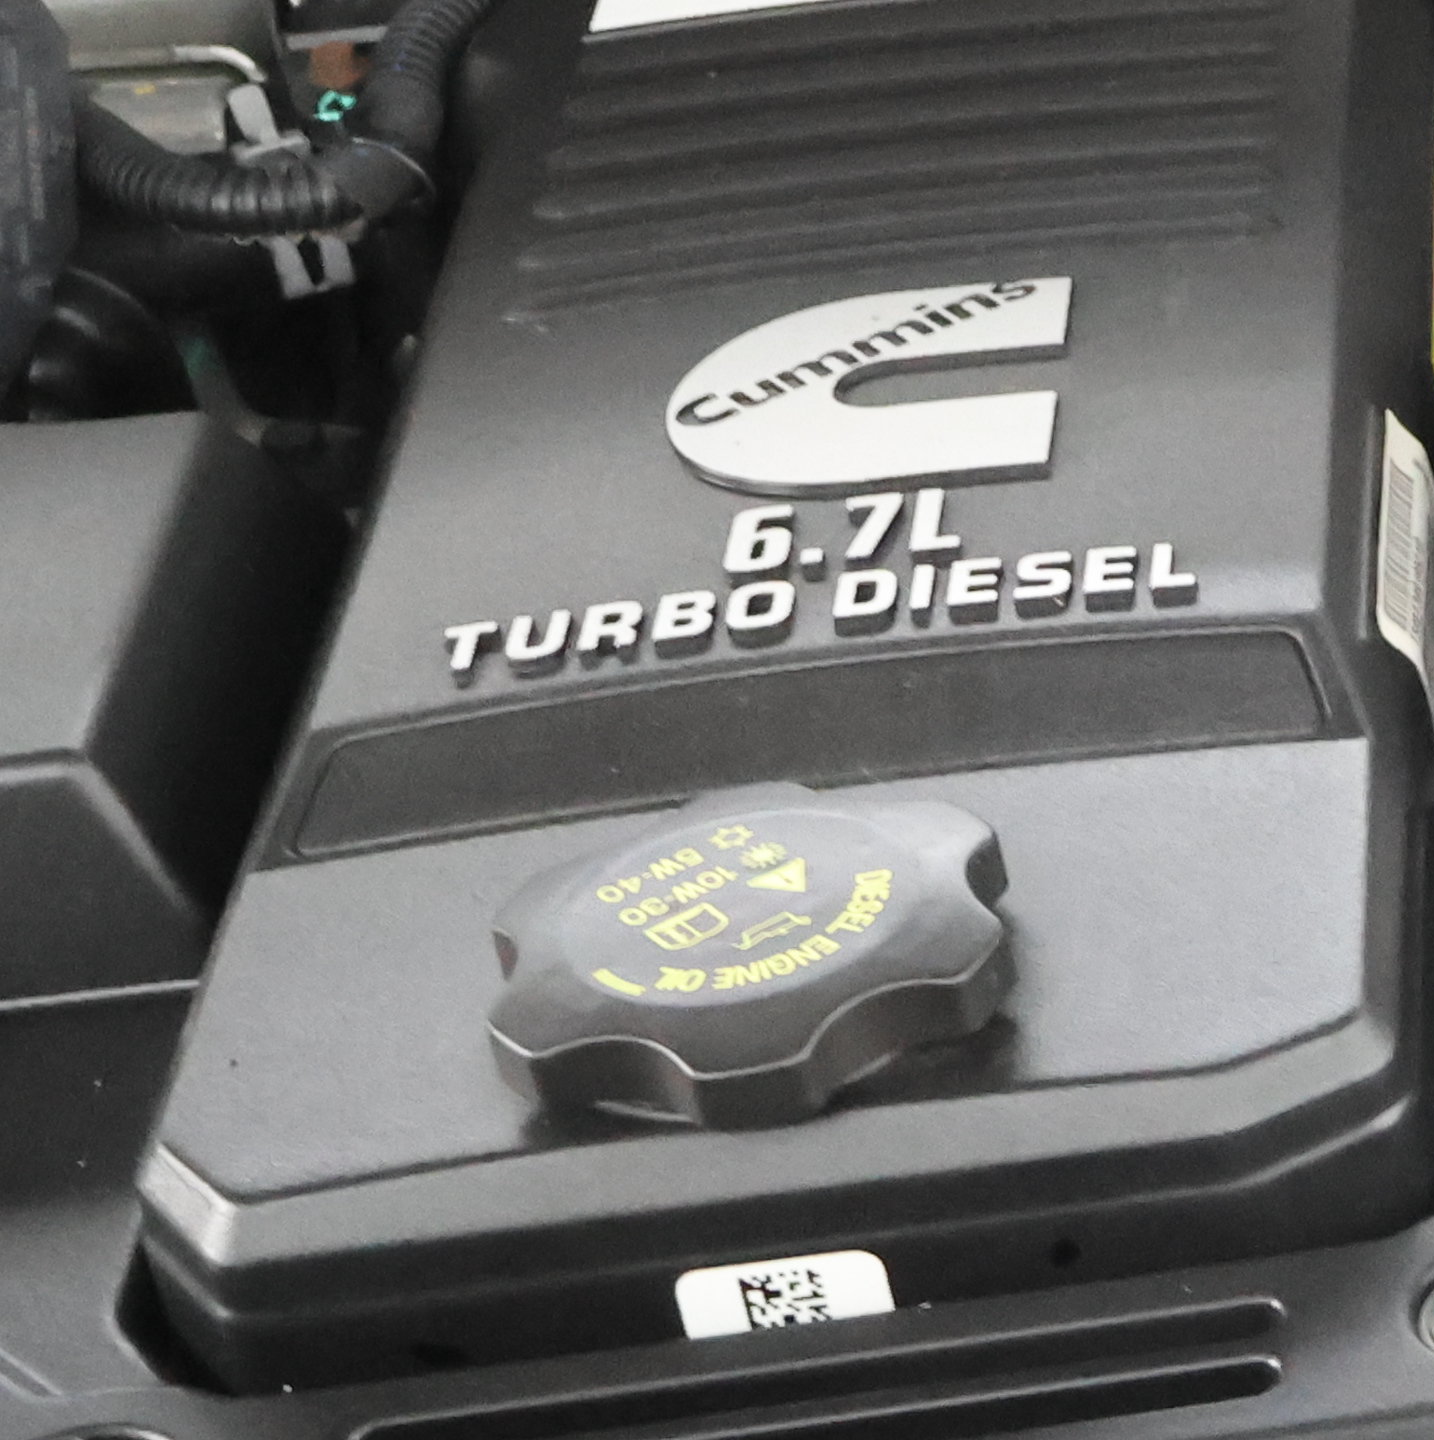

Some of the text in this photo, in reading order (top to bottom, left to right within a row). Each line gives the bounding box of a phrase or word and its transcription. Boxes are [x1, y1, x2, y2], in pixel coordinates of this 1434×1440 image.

[675, 278, 1037, 427] Cummins
[722, 487, 962, 580] 6.7L
[443, 541, 1199, 675] TURBO DIESEL
[595, 846, 705, 904] 5W-40
[617, 864, 738, 927] 10W-30
[824, 867, 894, 936] DIESEL
[711, 935, 842, 990] ENGINE
